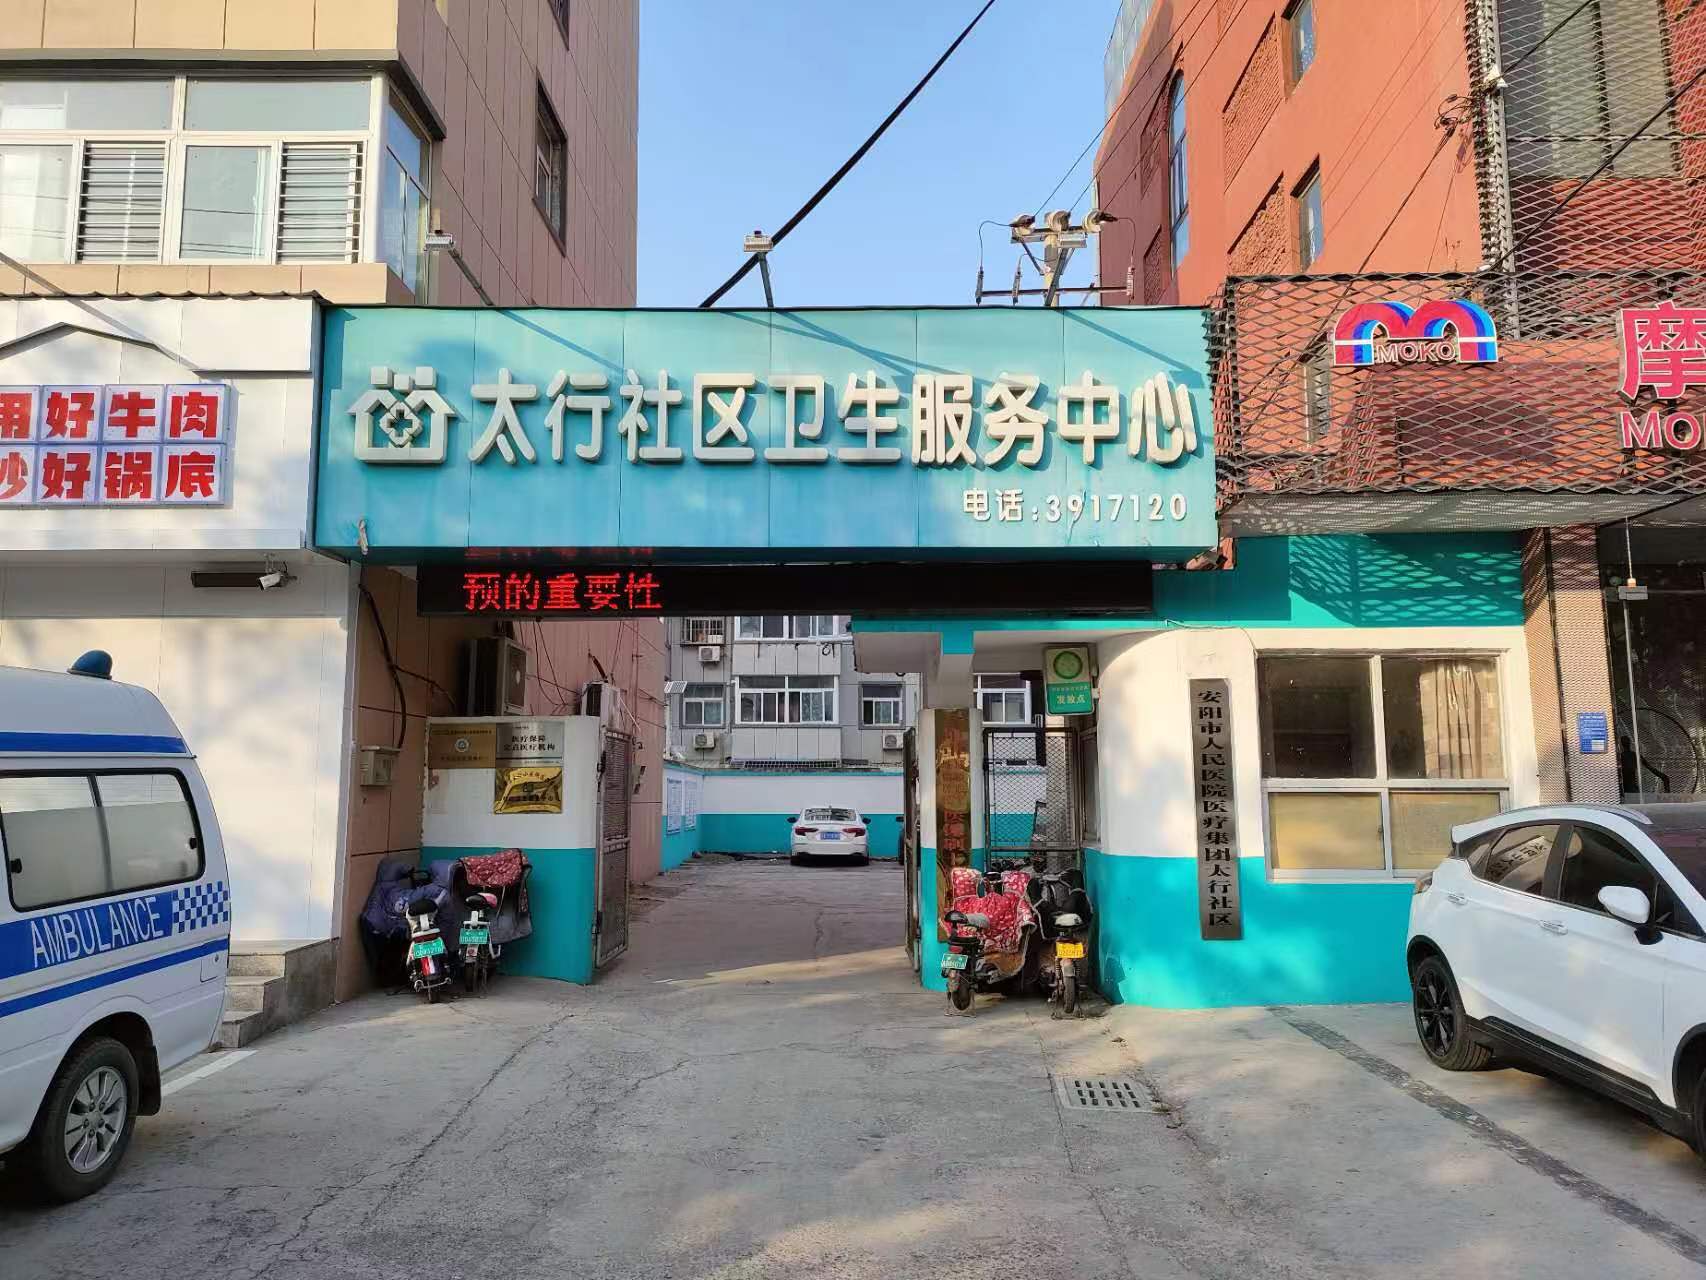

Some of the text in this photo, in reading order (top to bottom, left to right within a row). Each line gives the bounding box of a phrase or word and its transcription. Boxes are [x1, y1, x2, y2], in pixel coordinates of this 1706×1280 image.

[1376, 342, 1455, 363] MOKO
[1619, 299, 1706, 400] 摩
[467, 367, 1198, 467] 太行社区卫生服务中心
[1620, 411, 1706, 450] MO
[463, 572, 662, 610] 预的重要性
[1197, 689, 1234, 927] 安阳市人民医院医疗集团太行社区
[31, 896, 163, 968] AMBULANCE
